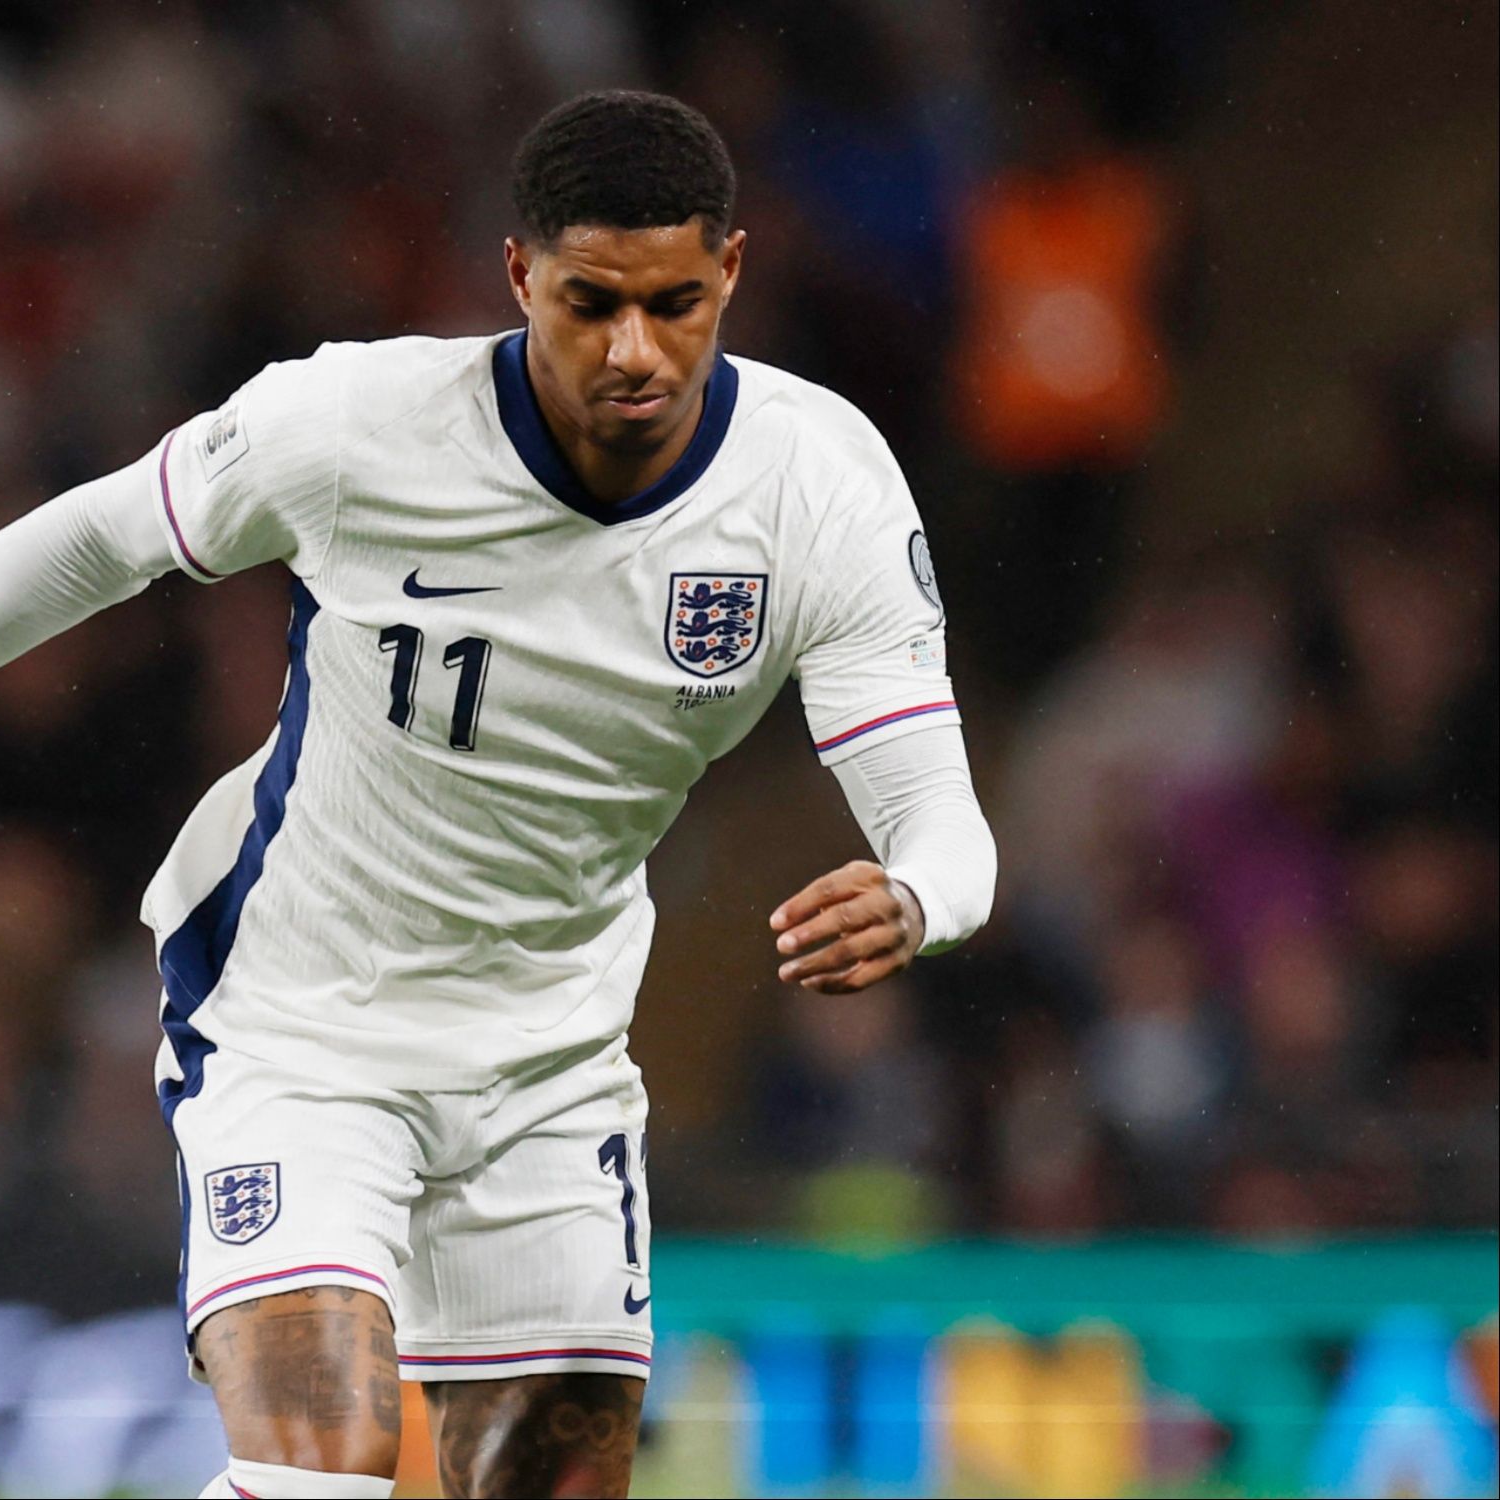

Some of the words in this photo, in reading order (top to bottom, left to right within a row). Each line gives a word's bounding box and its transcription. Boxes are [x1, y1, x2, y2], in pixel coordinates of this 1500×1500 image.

[378, 623, 492, 752] 11
[675, 684, 736, 699] ALBANIA
[597, 1132, 649, 1270] 1
